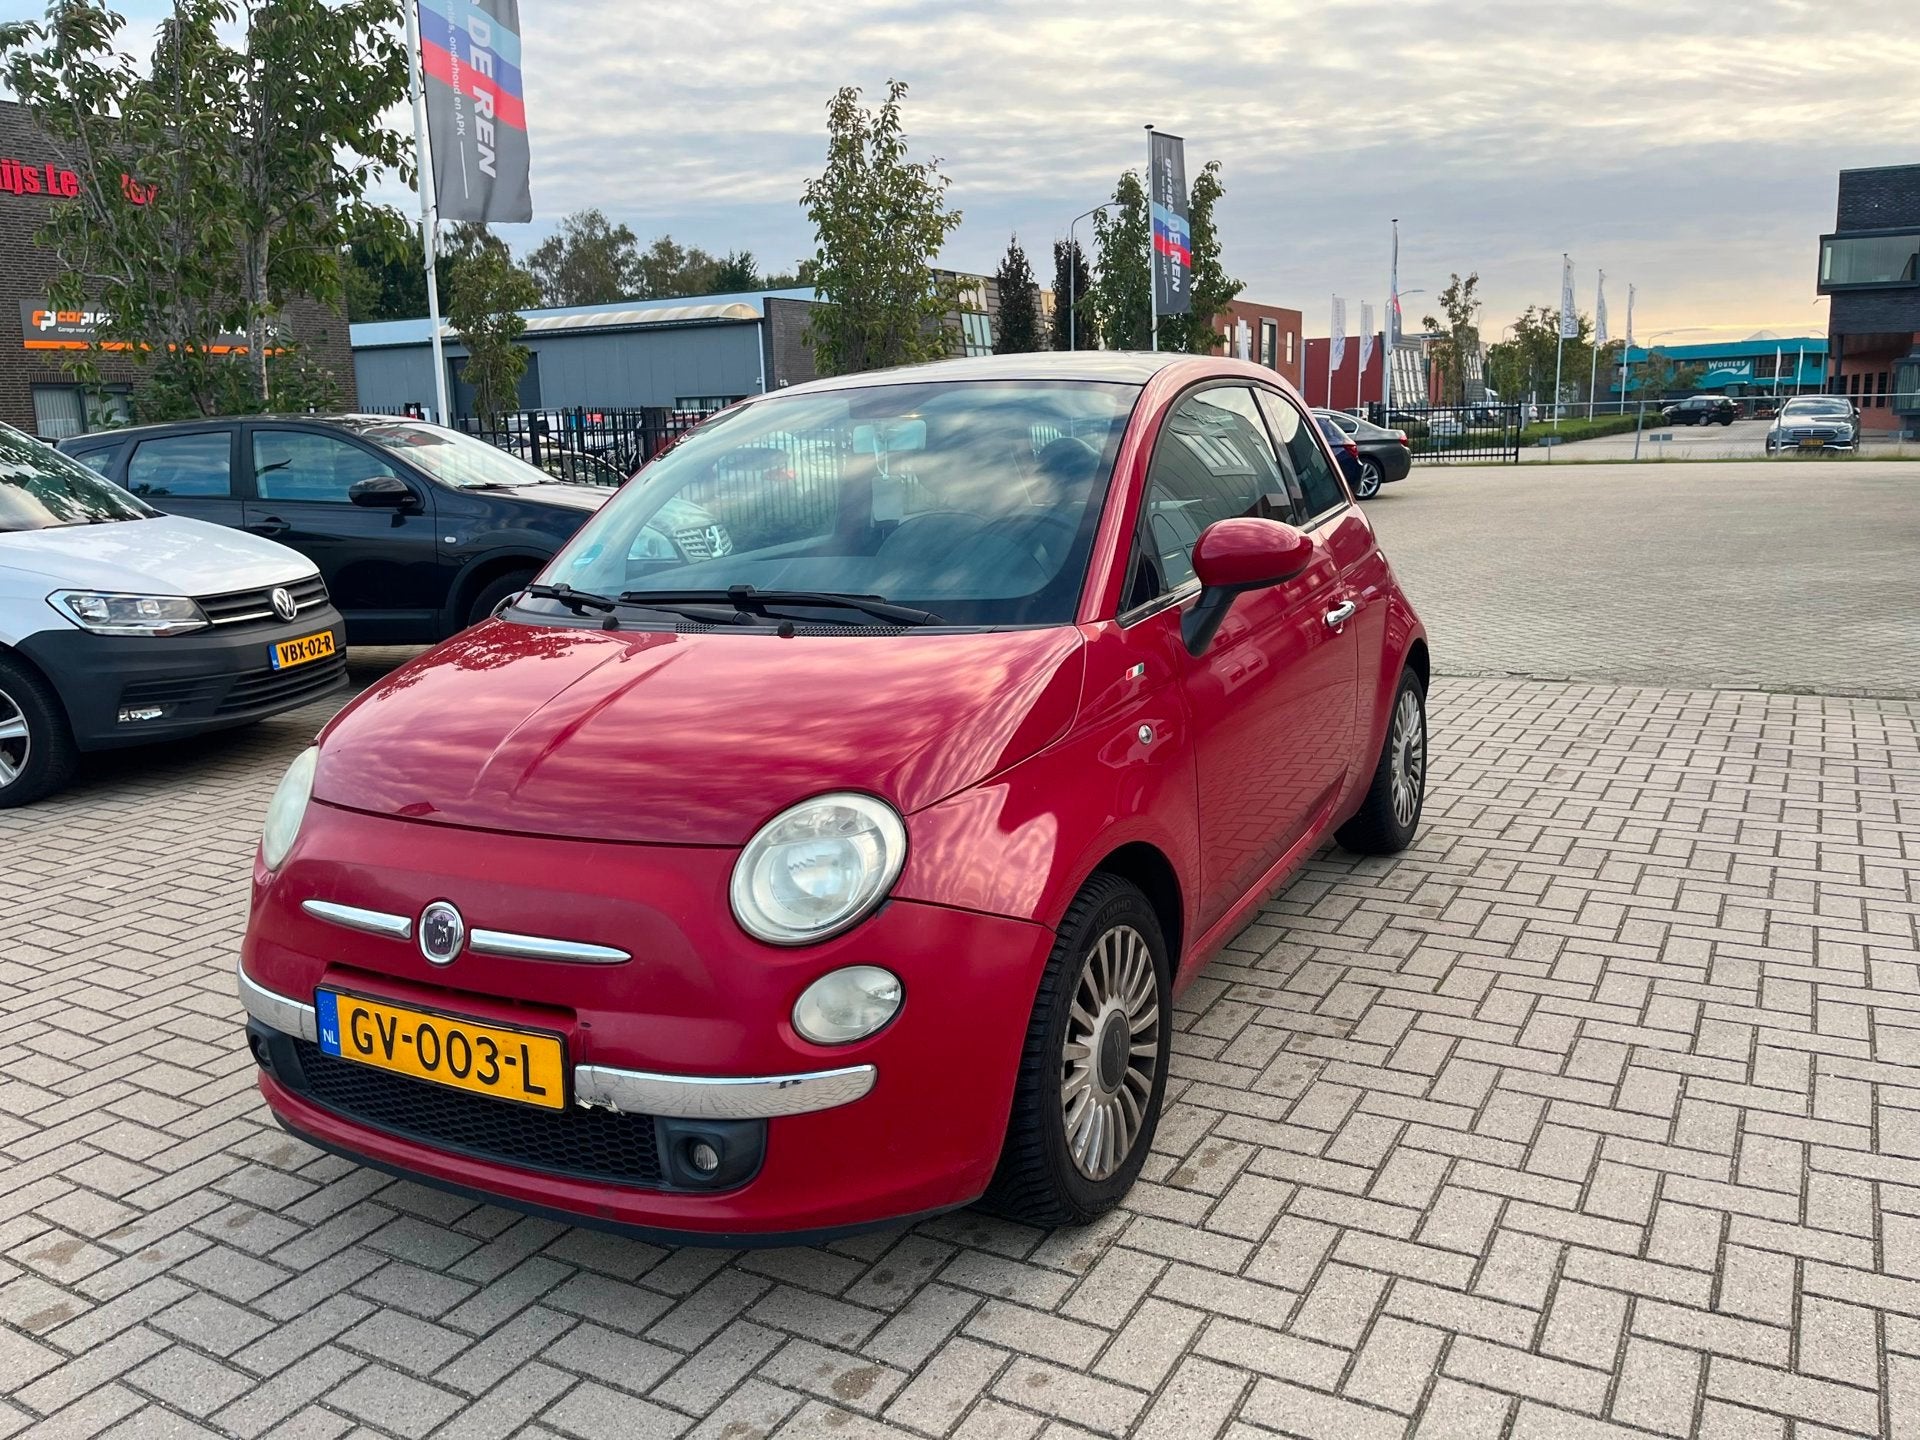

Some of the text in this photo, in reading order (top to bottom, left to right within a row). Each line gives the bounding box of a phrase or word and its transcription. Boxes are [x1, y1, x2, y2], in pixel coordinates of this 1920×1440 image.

[449, 37, 462, 95] onderhoud
[453, 97, 461, 110] en
[467, 14, 497, 178] DE REN
[455, 112, 465, 135] APK
[0, 159, 40, 195] ijs
[1165, 158, 1181, 292] garage DE REN
[281, 635, 333, 663] VBX-02-R
[323, 1028, 338, 1045] NL
[351, 1007, 546, 1096] GV-003-L
